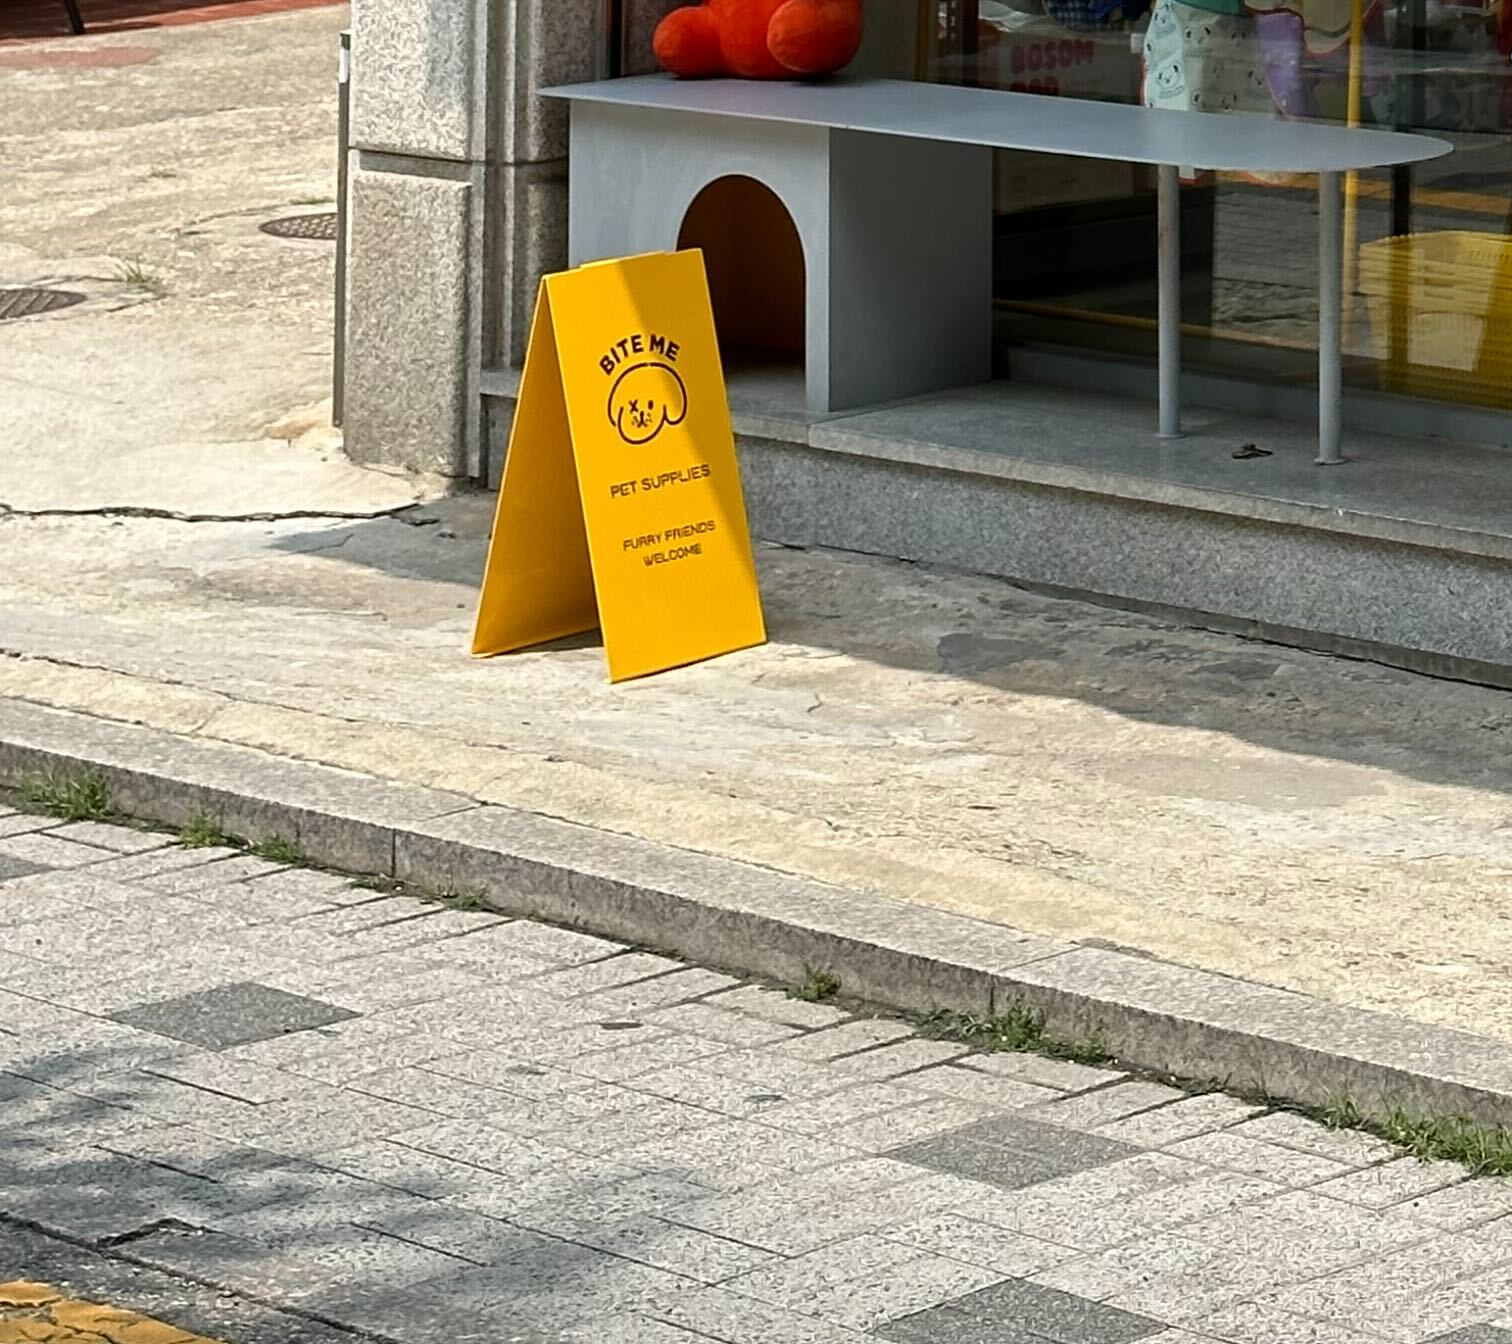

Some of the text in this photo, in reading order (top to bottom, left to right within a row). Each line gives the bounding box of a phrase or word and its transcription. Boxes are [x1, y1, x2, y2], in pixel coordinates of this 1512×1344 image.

[599, 333, 680, 376] BITE ME
[610, 464, 711, 499] PET SUPPLIES
[623, 520, 716, 552] FURRY FRIENDS
[642, 542, 702, 567] WELCOME
